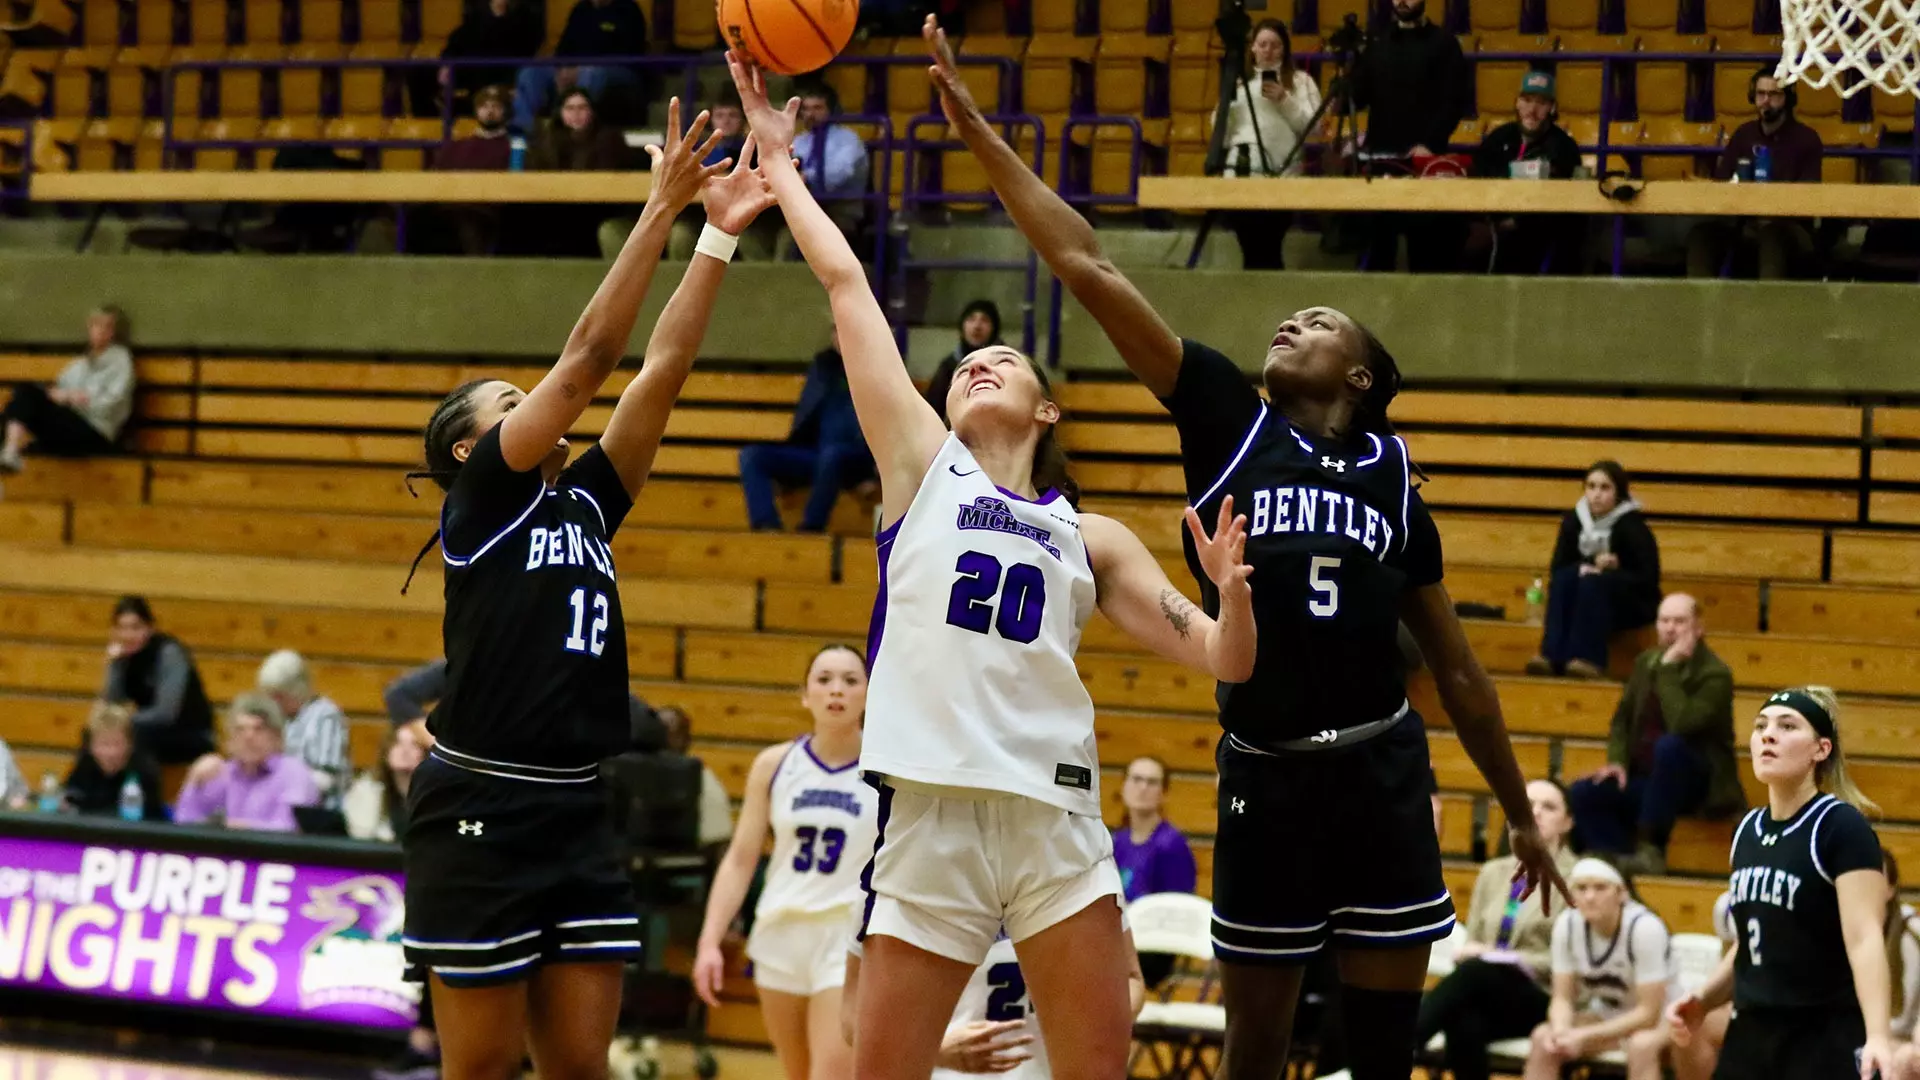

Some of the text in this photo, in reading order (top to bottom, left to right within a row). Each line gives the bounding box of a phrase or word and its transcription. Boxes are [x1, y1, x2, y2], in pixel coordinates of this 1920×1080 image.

[1251, 487, 1394, 562] BENTLEY
[946, 549, 1046, 645] 20
[1309, 555, 1342, 617] 5
[565, 588, 609, 657] 12
[792, 825, 847, 875] 33
[80, 846, 296, 925] PURPLE
[1747, 917, 1762, 967] 2
[986, 962, 1035, 1021] 2
